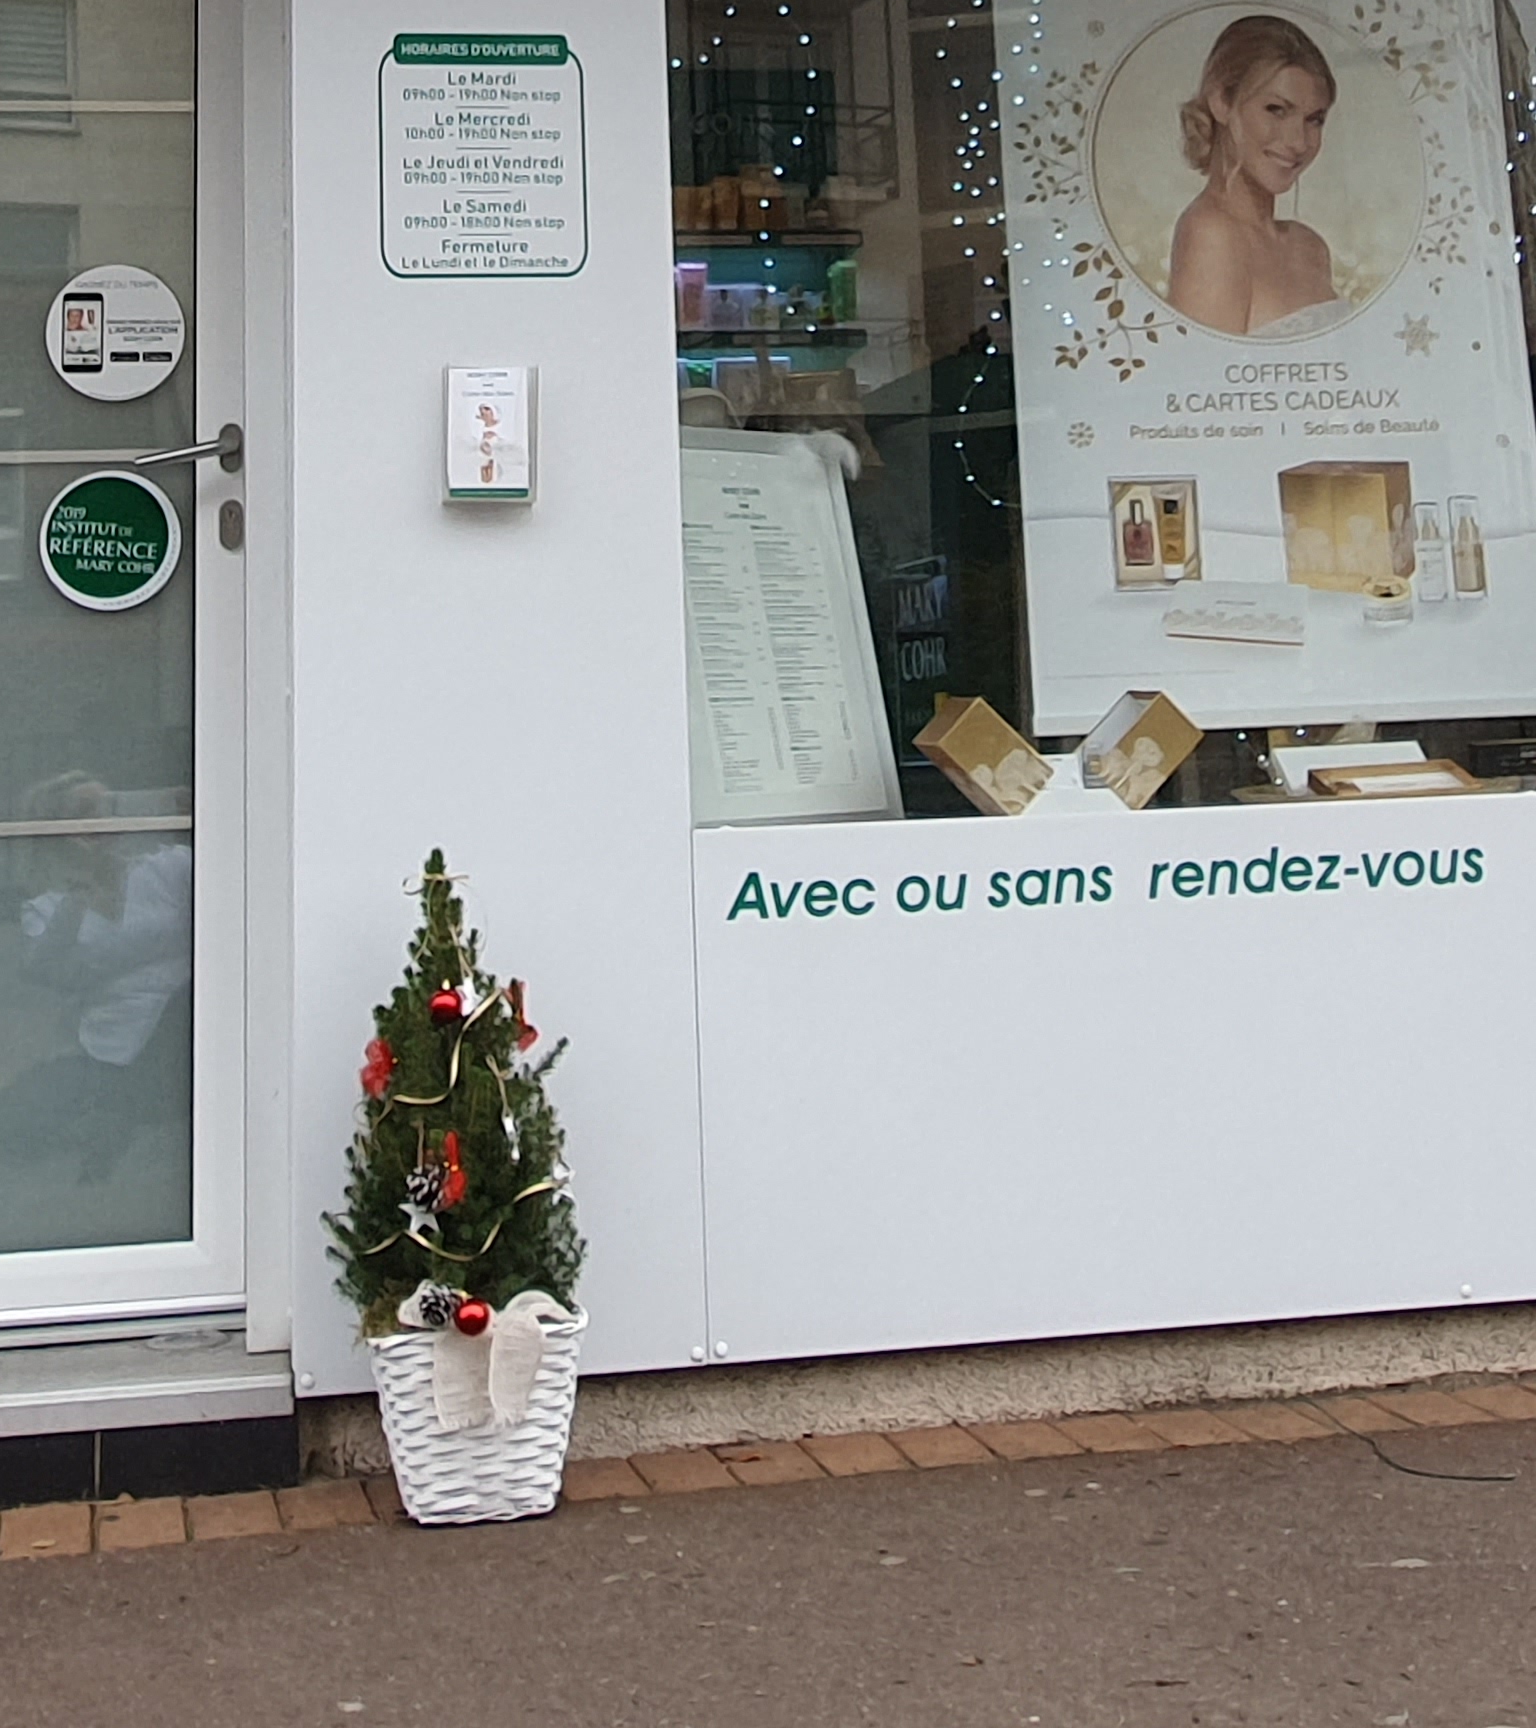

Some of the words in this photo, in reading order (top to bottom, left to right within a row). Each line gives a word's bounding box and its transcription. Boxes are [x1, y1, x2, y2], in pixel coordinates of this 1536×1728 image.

[400, 43, 469, 57] HORAIRES
[470, 43, 560, 57] D'OUVERTURE
[448, 72, 467, 86] Le
[470, 71, 517, 86] Mardi
[434, 112, 455, 126] Le
[458, 112, 532, 126] Mercredi
[402, 156, 422, 170] Le
[427, 155, 470, 170] Jeudi
[492, 155, 564, 170] Vendredi
[443, 199, 462, 214] Le
[466, 199, 527, 214] Samedi
[441, 239, 529, 254] Fermeture
[1224, 362, 1348, 385] COFFRETS
[1166, 394, 1181, 413] &
[1185, 392, 1278, 413] CARTES
[1285, 389, 1400, 412] CADEAUX
[1129, 423, 1200, 440] Produits
[1204, 423, 1225, 439] de
[1229, 422, 1264, 438] soin
[1303, 420, 1351, 437] Soins
[1354, 419, 1375, 435] de
[1380, 417, 1440, 434] Beauté
[51, 519, 118, 537] INSTITUT
[49, 534, 158, 560] RÉFÉRENCE
[75, 558, 114, 572] MARY
[900, 636, 948, 681] COHR
[725, 871, 877, 921] Avec
[895, 872, 966, 914] ou
[987, 862, 1113, 907] sans
[1146, 844, 1486, 901] rendez-vous
